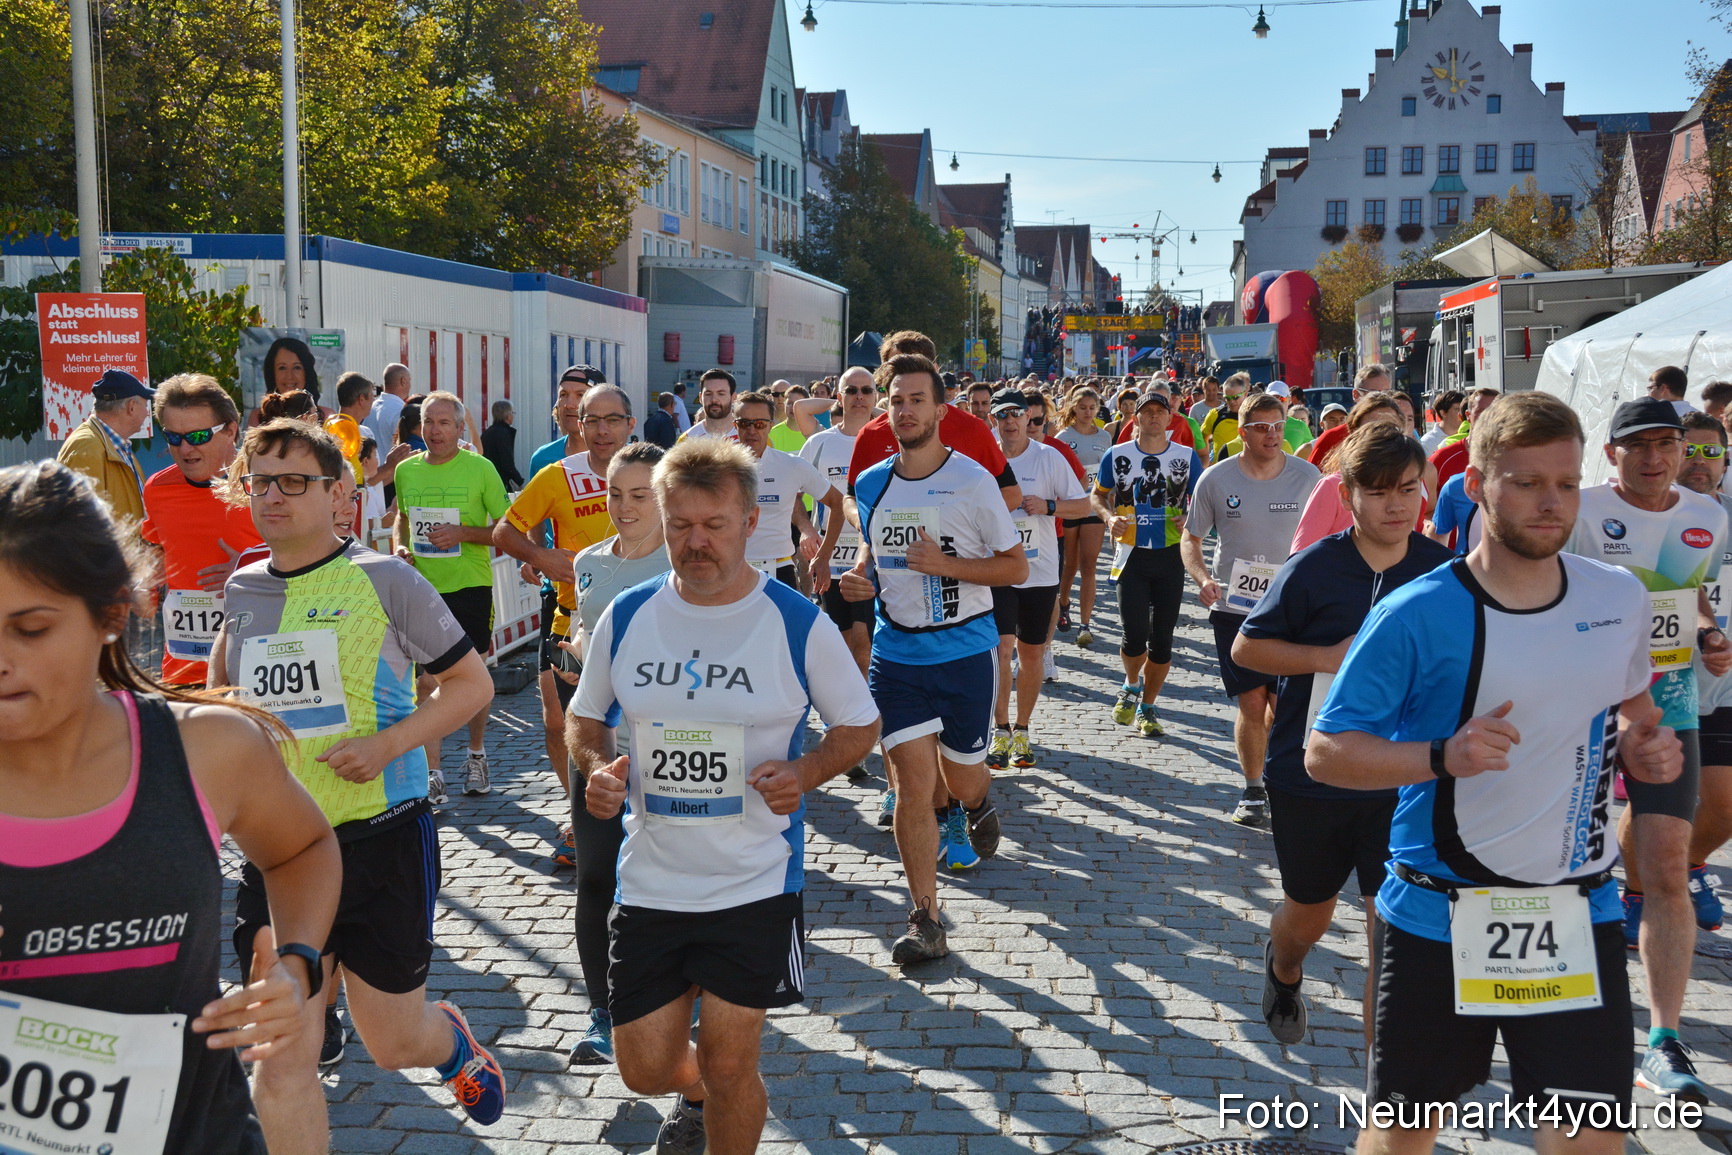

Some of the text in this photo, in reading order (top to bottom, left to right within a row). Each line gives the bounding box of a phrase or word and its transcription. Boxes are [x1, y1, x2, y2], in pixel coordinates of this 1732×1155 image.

[48, 303, 139, 319] Abschluss
[48, 320, 78, 329] statt
[1096, 318, 1131, 327] START
[50, 331, 140, 344] Ausschluss!
[66, 353, 138, 362] Mehr Lehrer für
[62, 364, 101, 373] kleinere
[1269, 503, 1299, 511] BOCK
[891, 513, 919, 521] BOCK
[882, 526, 926, 547] 250
[1238, 575, 1271, 593] 204
[181, 597, 213, 605] BOCK
[1651, 599, 1676, 608] OCK
[172, 609, 225, 632] 2112
[192, 644, 207, 653] Jan
[267, 641, 304, 655] BOCK
[253, 660, 320, 697] 3091
[634, 650, 755, 699] SUSPA
[282, 698, 312, 706] Neumarkt
[664, 729, 712, 742] BOCK
[651, 748, 728, 783] 2395
[658, 785, 678, 793] PARTL
[670, 800, 709, 814] Albert
[1566, 786, 1580, 824] WATER
[1558, 826, 1572, 869] Solutions
[1491, 896, 1550, 910] BOCK
[25, 912, 188, 956] OBSESSION
[1486, 920, 1559, 960] 274
[1485, 966, 1554, 974] PARTL Neumarkt
[1494, 983, 1562, 1000] Dominic
[16, 1016, 119, 1056] BOCK
[0, 1054, 131, 1133] 081
[0, 1122, 91, 1154] RTL Neumarkt
